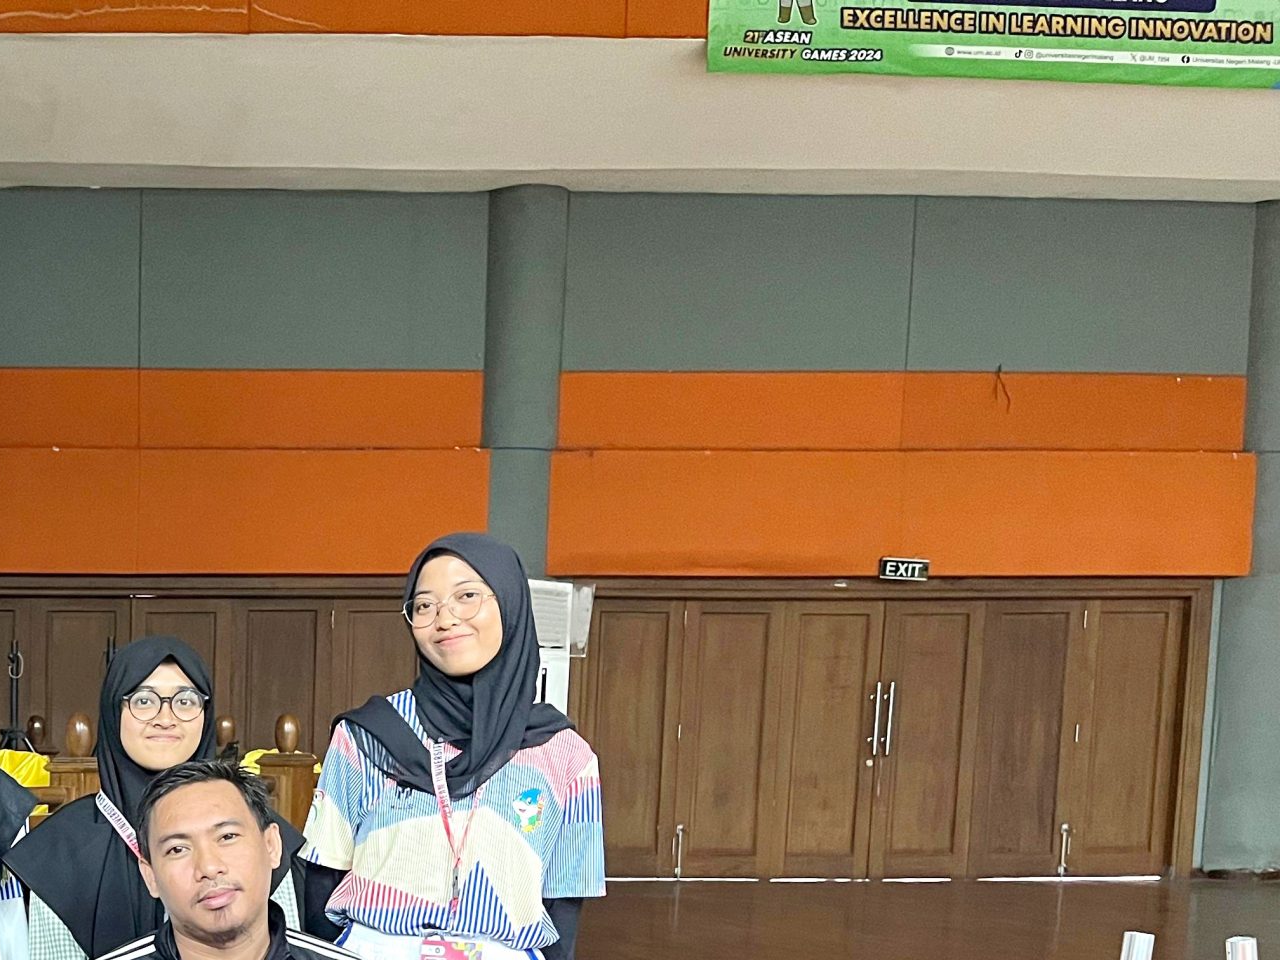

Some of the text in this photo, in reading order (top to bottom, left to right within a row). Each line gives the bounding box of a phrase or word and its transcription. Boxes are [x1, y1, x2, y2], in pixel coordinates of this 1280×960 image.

[842, 8, 1273, 43] EXCELLENCE IN LEARNING INNOVATION
[764, 32, 812, 45] ASEAN
[724, 46, 882, 61] UNIVERSITY GAMES 2024
[885, 561, 923, 577] EXIT
